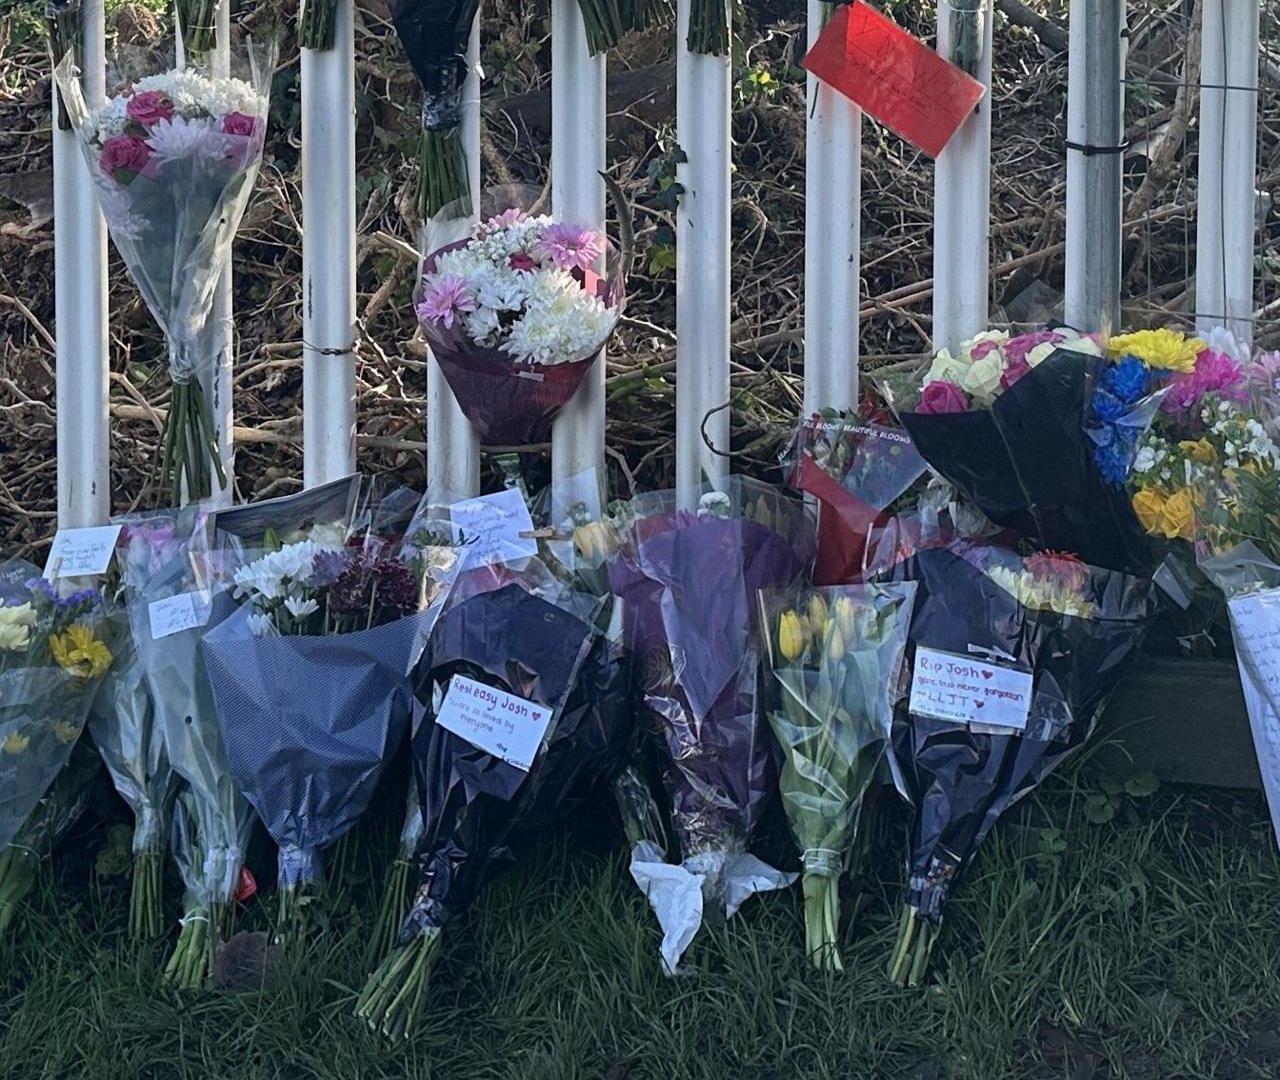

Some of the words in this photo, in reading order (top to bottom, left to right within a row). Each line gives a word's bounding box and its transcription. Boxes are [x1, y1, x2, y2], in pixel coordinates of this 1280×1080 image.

[843, 424, 878, 438] BEAUTIFUL
[946, 662, 980, 679] Josh
[956, 683, 981, 694] never
[454, 678, 473, 694] Rest
[473, 688, 498, 711] easy
[501, 695, 529, 717] Josh
[504, 718, 516, 734] by
